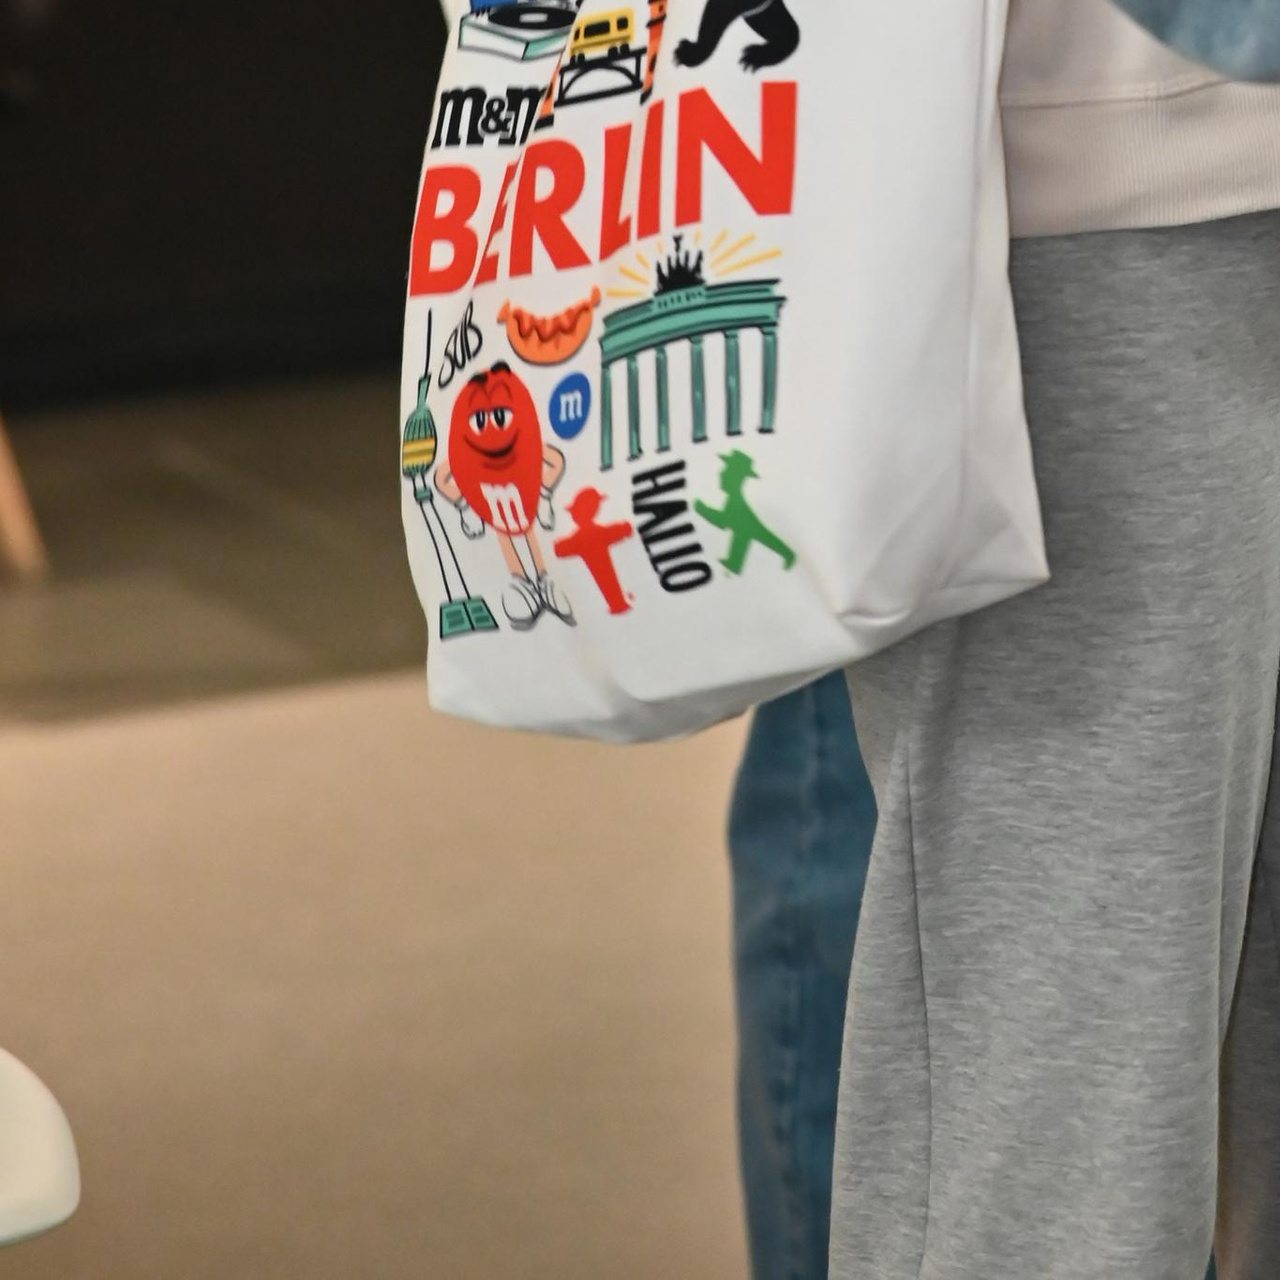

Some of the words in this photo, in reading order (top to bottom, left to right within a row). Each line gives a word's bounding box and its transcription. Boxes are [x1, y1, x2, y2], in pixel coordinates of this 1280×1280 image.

[408, 80, 798, 298] BERLIN
[559, 388, 583, 423] m
[479, 481, 530, 532] m
[631, 458, 713, 593] HALLO
